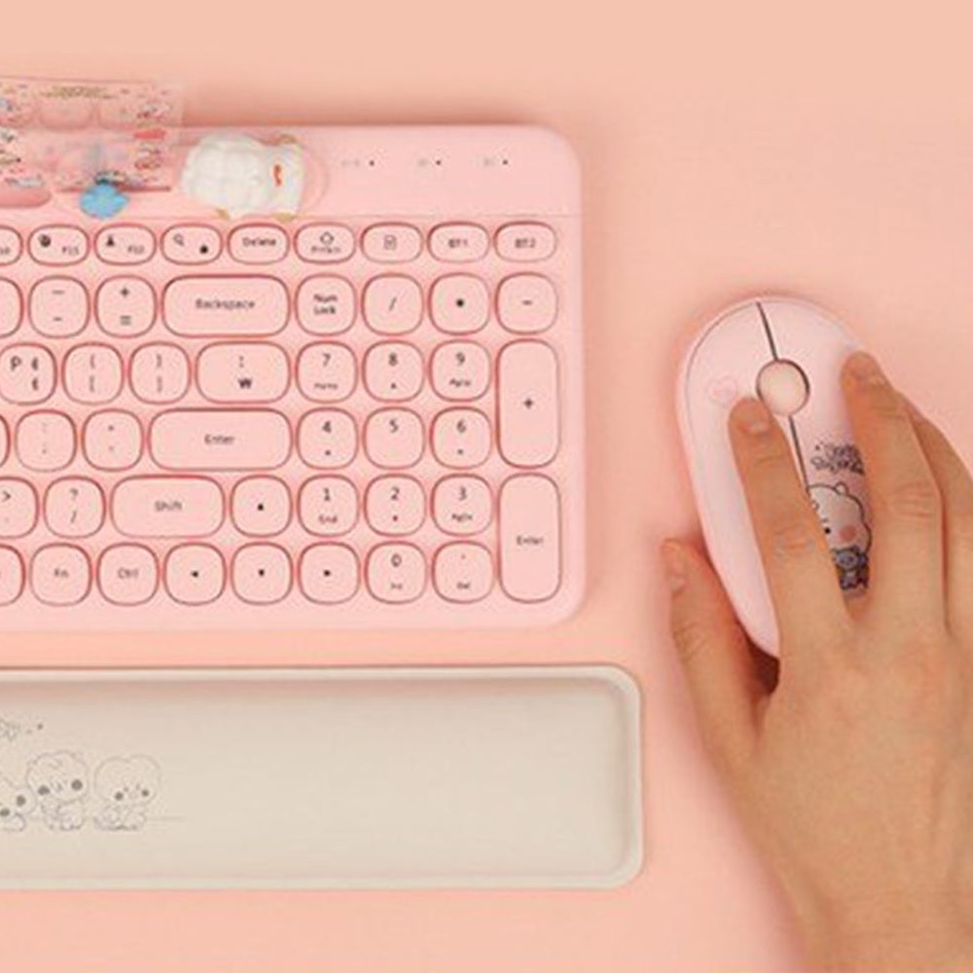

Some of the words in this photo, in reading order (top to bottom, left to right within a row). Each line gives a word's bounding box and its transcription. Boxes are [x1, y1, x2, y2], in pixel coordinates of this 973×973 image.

[242, 237, 277, 247] Delete
[195, 298, 256, 311] Backspace
[313, 293, 338, 304] Num
[314, 305, 336, 315] Lock
[9, 355, 23, 372] P
[322, 352, 332, 367] 7
[388, 352, 398, 367] 8
[455, 351, 466, 366] 9
[321, 420, 332, 434] 4
[389, 418, 399, 434] 5
[456, 419, 467, 434] 6
[203, 433, 235, 445] Enter
[390, 486, 400, 501] 2
[458, 486, 468, 501] 3
[154, 500, 183, 512] Shift
[516, 535, 544, 546] Enter
[390, 553, 403, 568] 0
[117, 567, 139, 580] Ctrl
